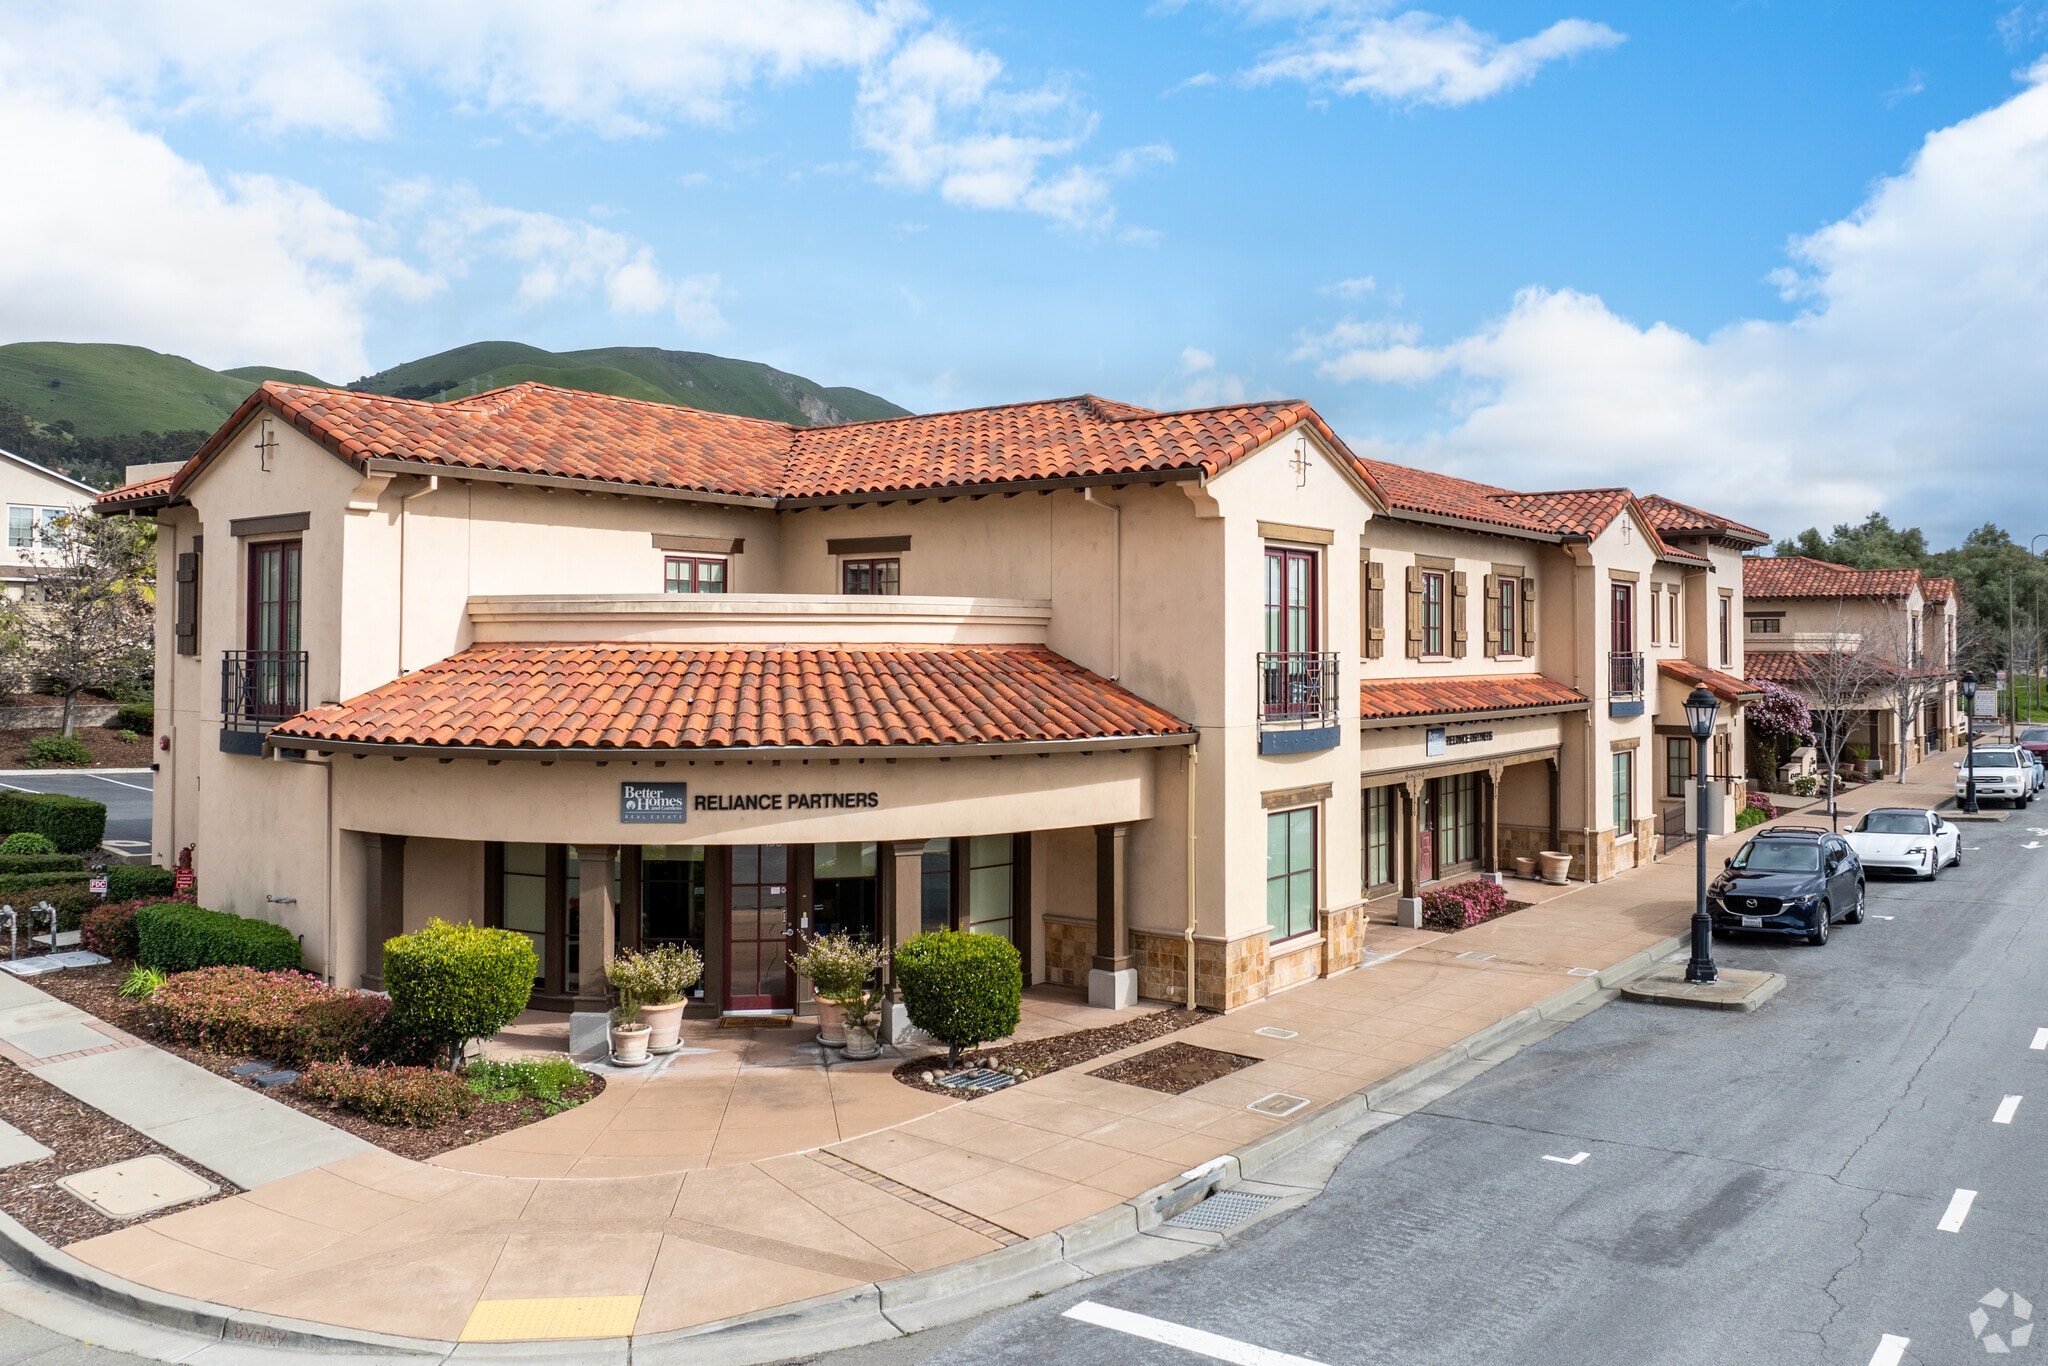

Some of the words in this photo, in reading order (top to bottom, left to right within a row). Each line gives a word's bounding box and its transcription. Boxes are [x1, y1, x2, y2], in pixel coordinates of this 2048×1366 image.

[624, 786, 663, 799] Better
[637, 797, 683, 811] Homes
[694, 794, 782, 811] RELIANCE
[788, 792, 879, 809] PARTNERS
[91, 881, 106, 889] FDC
